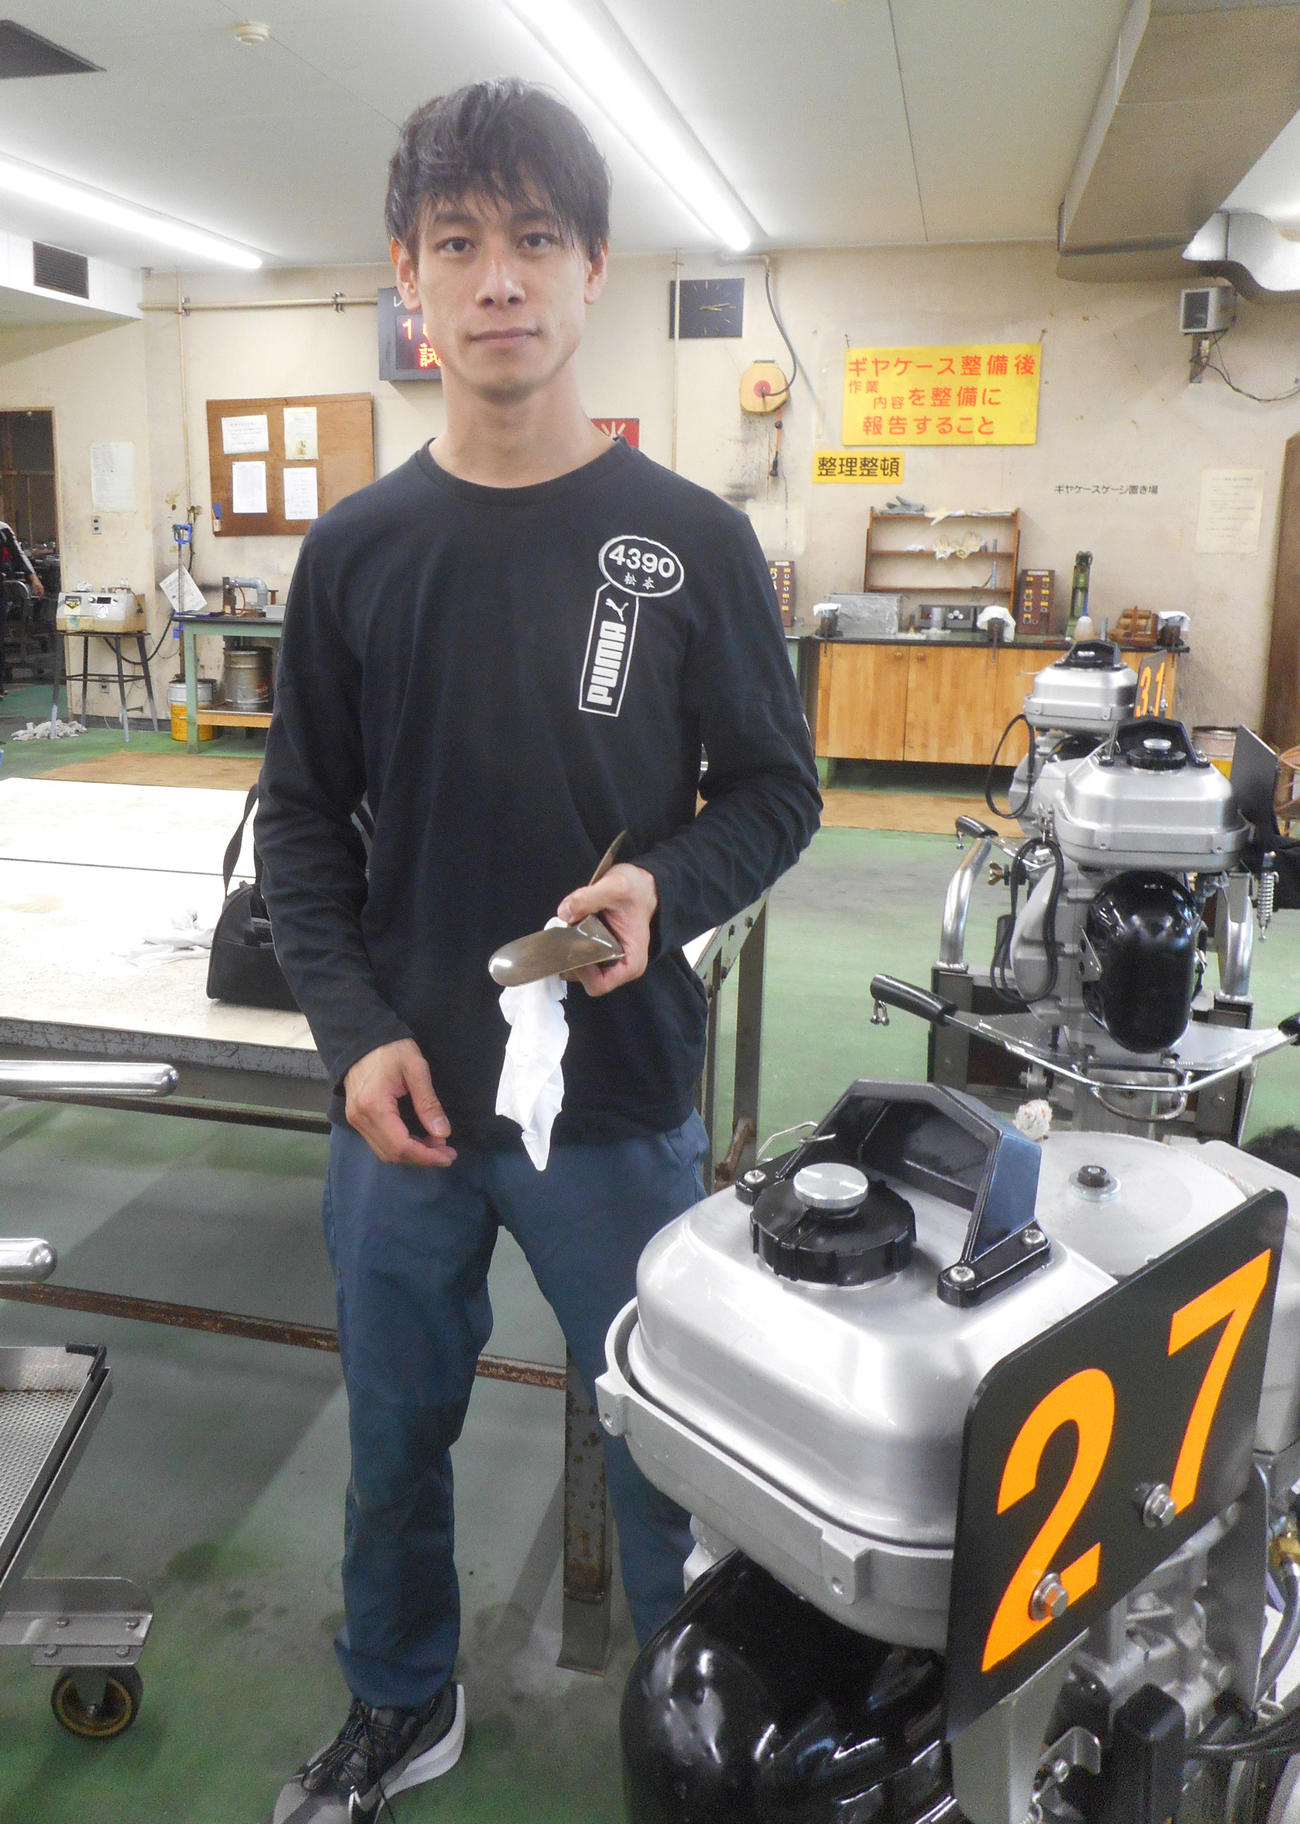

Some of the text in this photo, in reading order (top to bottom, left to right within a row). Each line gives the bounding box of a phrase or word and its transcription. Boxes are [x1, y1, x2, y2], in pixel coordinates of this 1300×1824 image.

[848, 354, 1036, 377] ギヤケース整備後
[849, 380, 879, 393] 作業
[908, 386, 1001, 406] を整備に
[862, 416, 994, 435] 報告すること
[817, 456, 900, 477] 整理整頓
[609, 544, 675, 578] 4390
[586, 620, 627, 706] PUMA
[1135, 662, 1165, 718] 31
[982, 1249, 1271, 1673] 27
